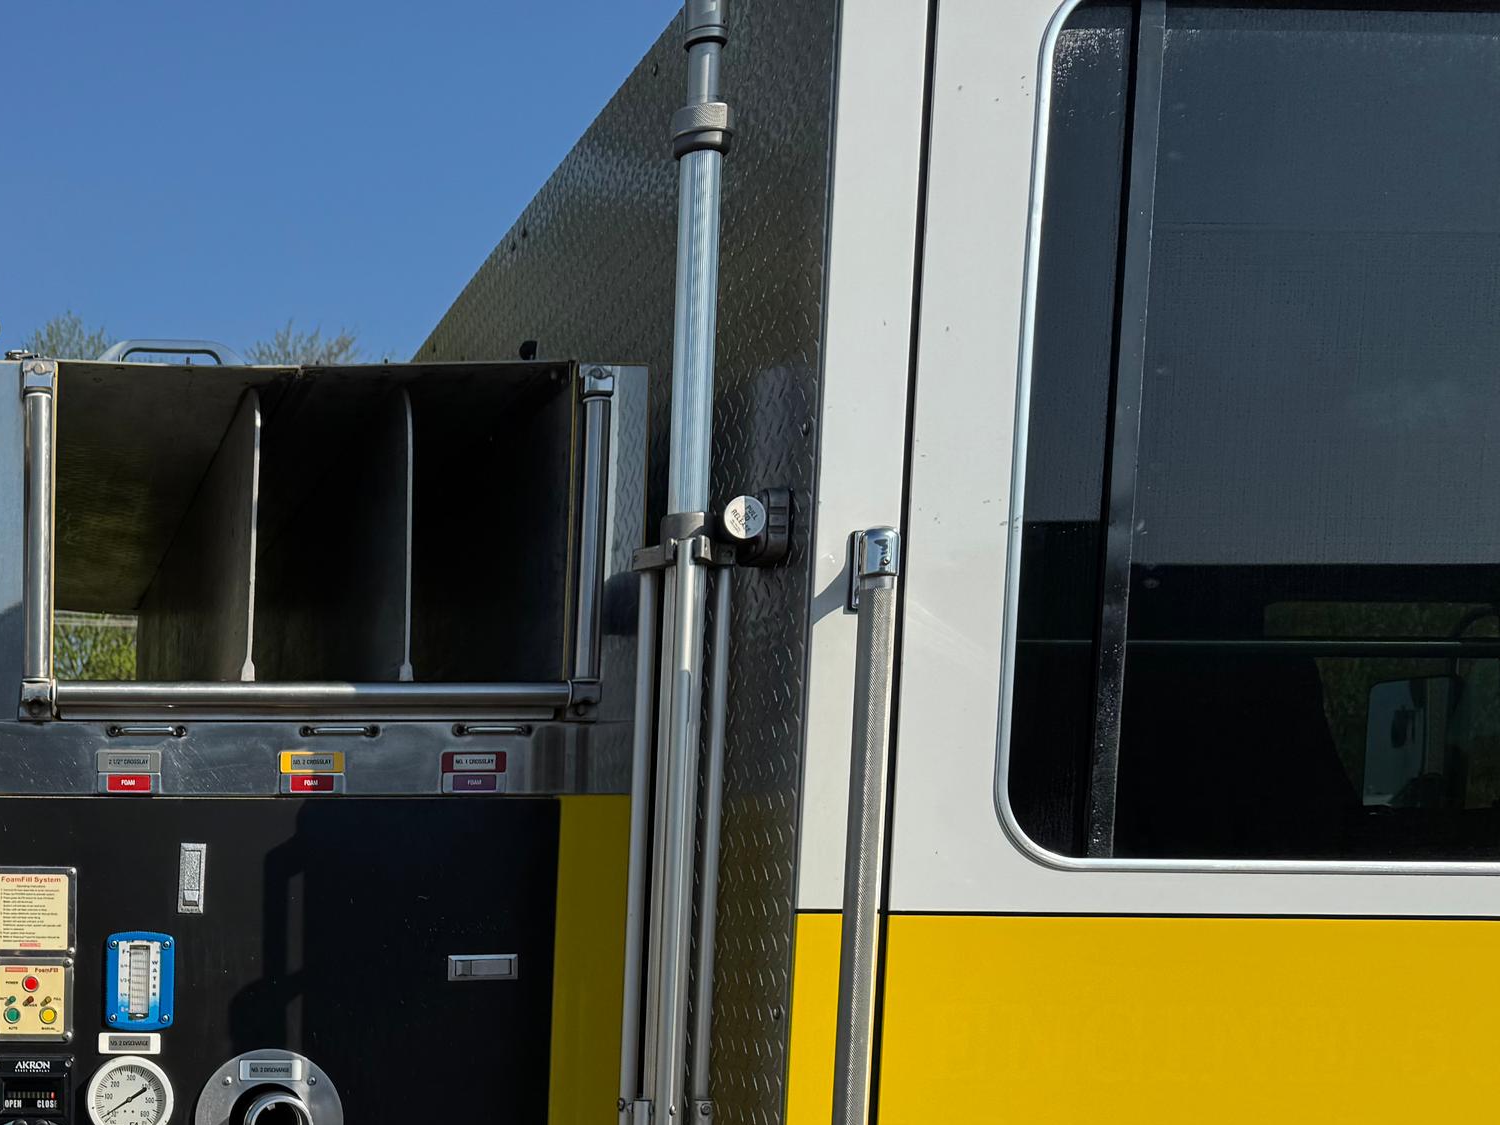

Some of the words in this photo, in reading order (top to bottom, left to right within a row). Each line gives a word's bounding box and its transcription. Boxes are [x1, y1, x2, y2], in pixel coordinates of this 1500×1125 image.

[746, 504, 758, 520] PULL
[34, 876, 62, 884] System
[151, 960, 159, 998] WATER
[15, 1060, 50, 1069] AKRON
[4, 1100, 22, 1108] OPEN
[36, 1100, 58, 1108] CLOSE
